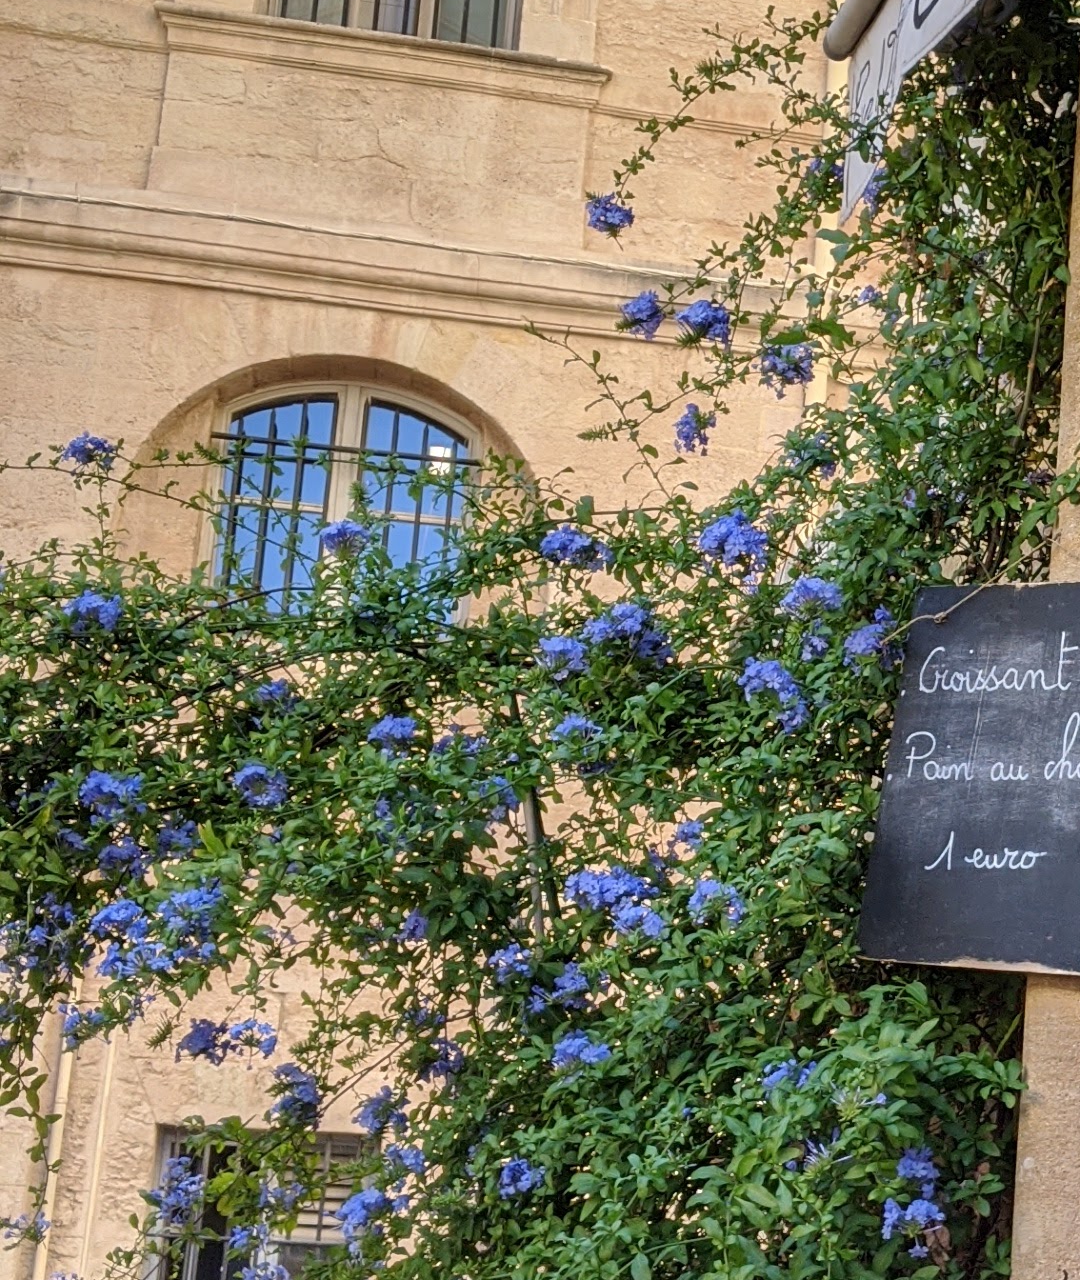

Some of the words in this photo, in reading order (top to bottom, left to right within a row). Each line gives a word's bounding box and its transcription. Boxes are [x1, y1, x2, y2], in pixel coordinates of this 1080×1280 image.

[920, 631, 1078, 693] Croissant
[905, 731, 973, 781] Pain
[991, 759, 1028, 781] au
[924, 831, 953, 871] 1
[965, 846, 1047, 870] euro
